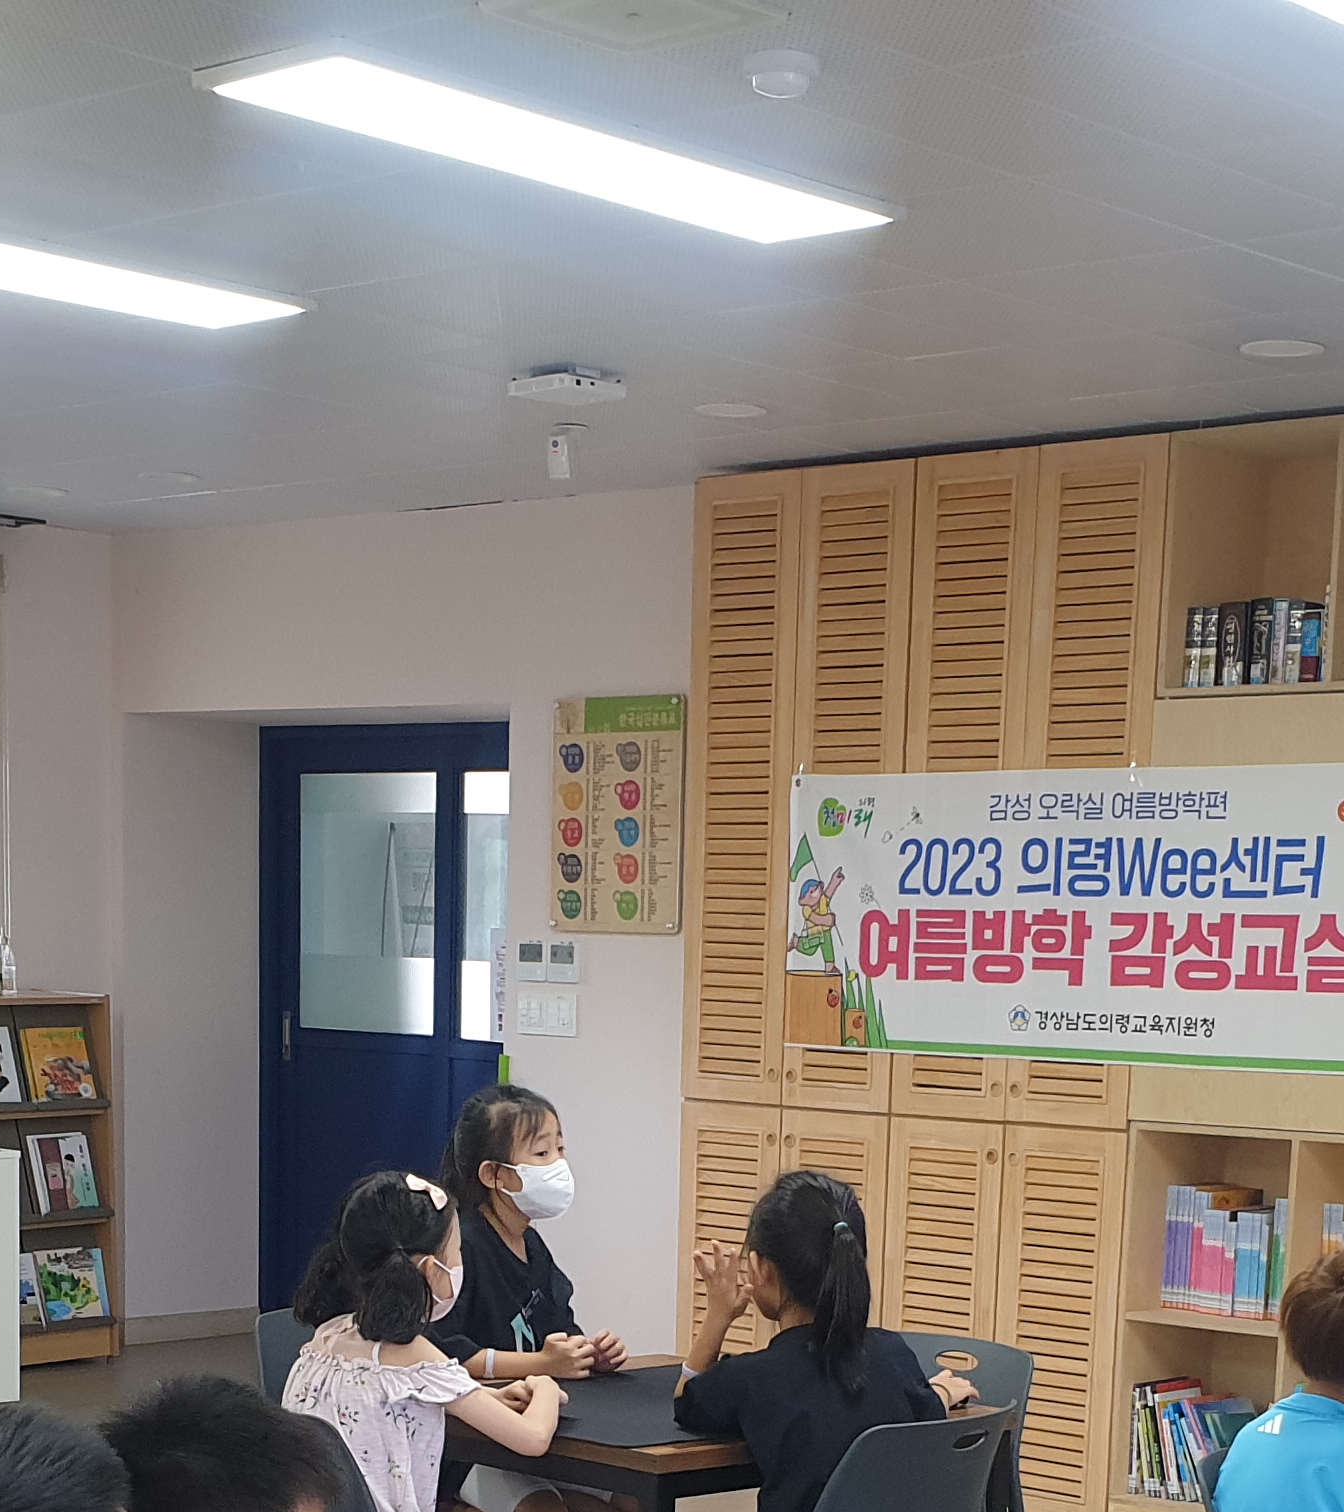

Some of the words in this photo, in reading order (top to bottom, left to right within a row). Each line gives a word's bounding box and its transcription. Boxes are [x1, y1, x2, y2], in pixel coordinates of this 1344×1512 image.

[988, 793, 1031, 821] 감성
[1037, 792, 1103, 820] 오락실
[1112, 790, 1228, 820] 여름방학편
[898, 837, 1002, 897] 2023
[1017, 835, 1325, 899] 의령Wee센터
[858, 907, 1092, 986] 여름방학
[1035, 1010, 1215, 1038] 경상남도의령교육지원청
